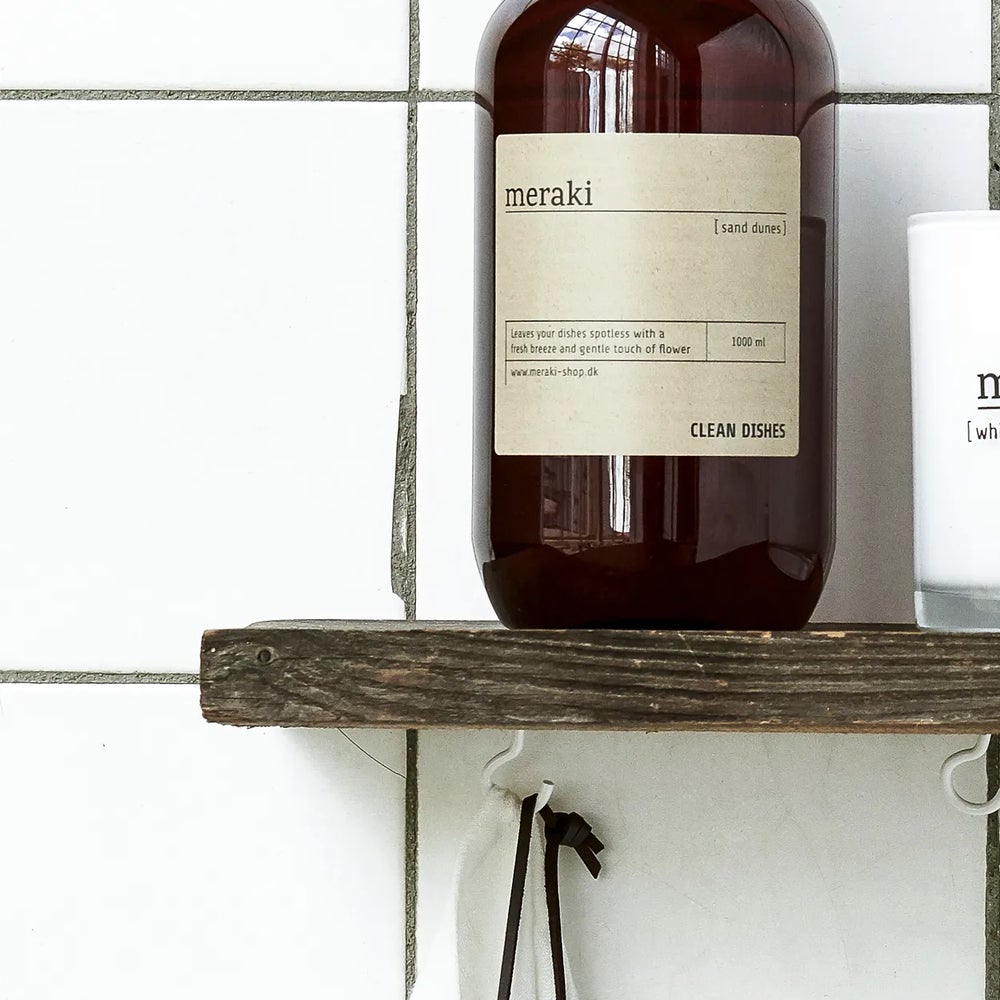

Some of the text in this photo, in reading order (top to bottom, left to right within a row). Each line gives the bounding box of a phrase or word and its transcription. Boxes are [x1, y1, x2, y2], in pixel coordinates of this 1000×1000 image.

[505, 180, 593, 207] meraki
[511, 328, 665, 340] Leaves your dishes spotless with a
[731, 336, 766, 347] 1000 ml
[511, 343, 691, 356] fresh breeze and gentle touch of flower
[511, 366, 599, 378] www.meraki-shop.dk
[690, 422, 786, 439] CLEAN DISHES
